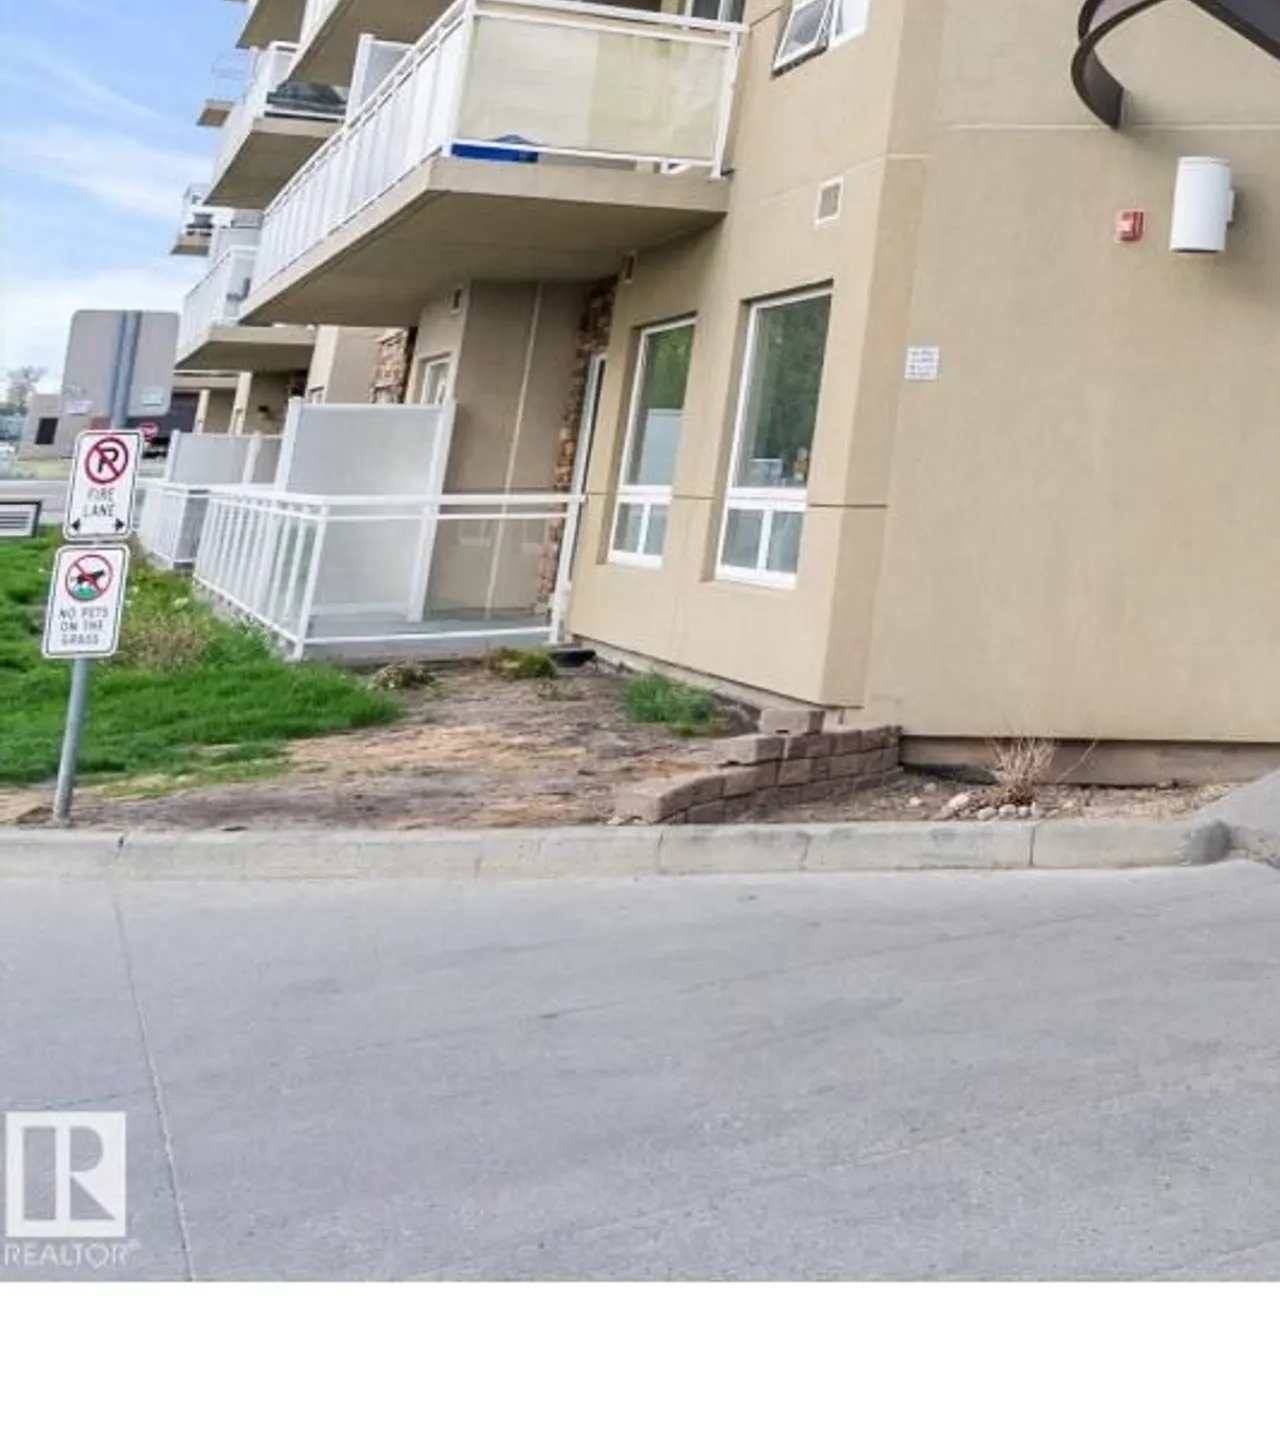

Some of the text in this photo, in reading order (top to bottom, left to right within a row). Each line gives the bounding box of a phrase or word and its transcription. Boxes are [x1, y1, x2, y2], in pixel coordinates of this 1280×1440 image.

[86, 487, 116, 501] FIRE
[82, 503, 115, 517] LANE
[59, 606, 109, 620] NO PETS
[60, 621, 78, 632] ON
[61, 633, 99, 646] GRASS
